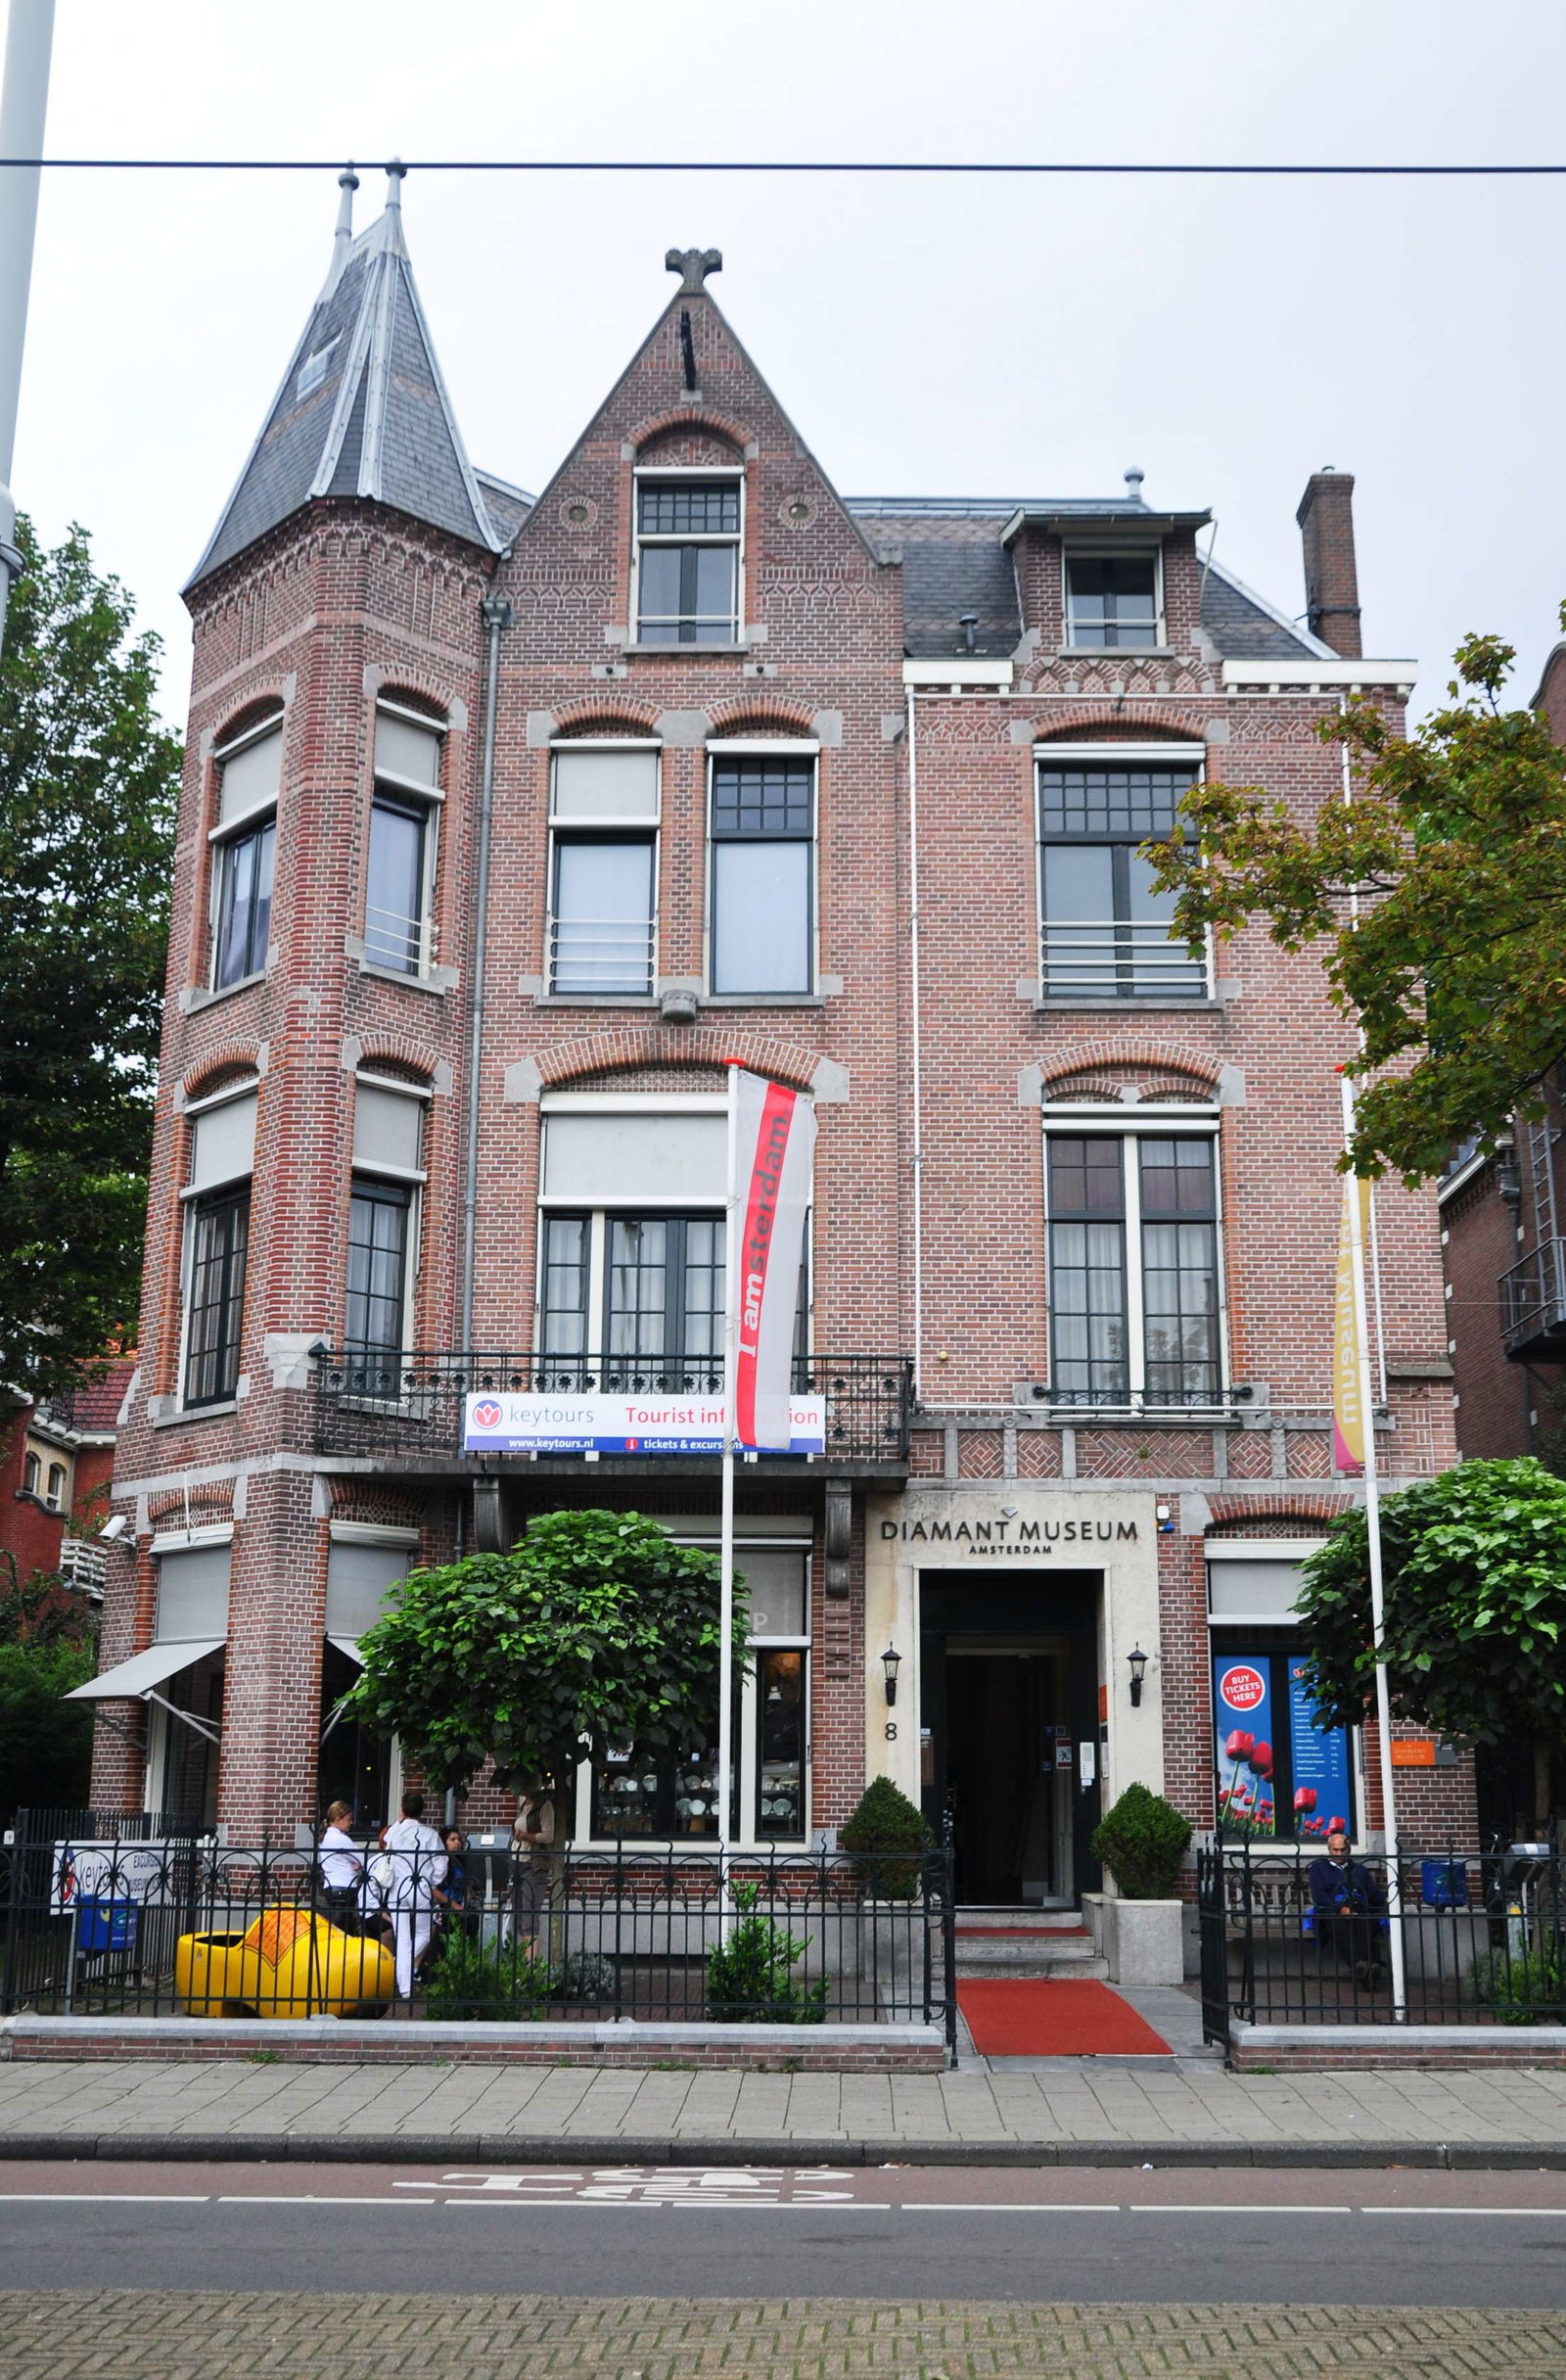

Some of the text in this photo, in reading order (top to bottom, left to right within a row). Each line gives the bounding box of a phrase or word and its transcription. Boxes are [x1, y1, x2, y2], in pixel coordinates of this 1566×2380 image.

[509, 1404, 595, 1427] keytours
[624, 1406, 695, 1423] Tourist
[508, 1437, 594, 1450] www.keytours.nl
[643, 1438, 745, 1450] tickets & excursns
[881, 1520, 1138, 1541] DIAMANT MUSEUM
[969, 1545, 1053, 1555] AMSTERDAM
[1231, 1674, 1250, 1685] BUY
[1224, 1681, 1261, 1695] TICKETS
[1233, 1692, 1257, 1703] HERE
[885, 1722, 898, 1741] 8
[79, 1855, 125, 1895] keytos
